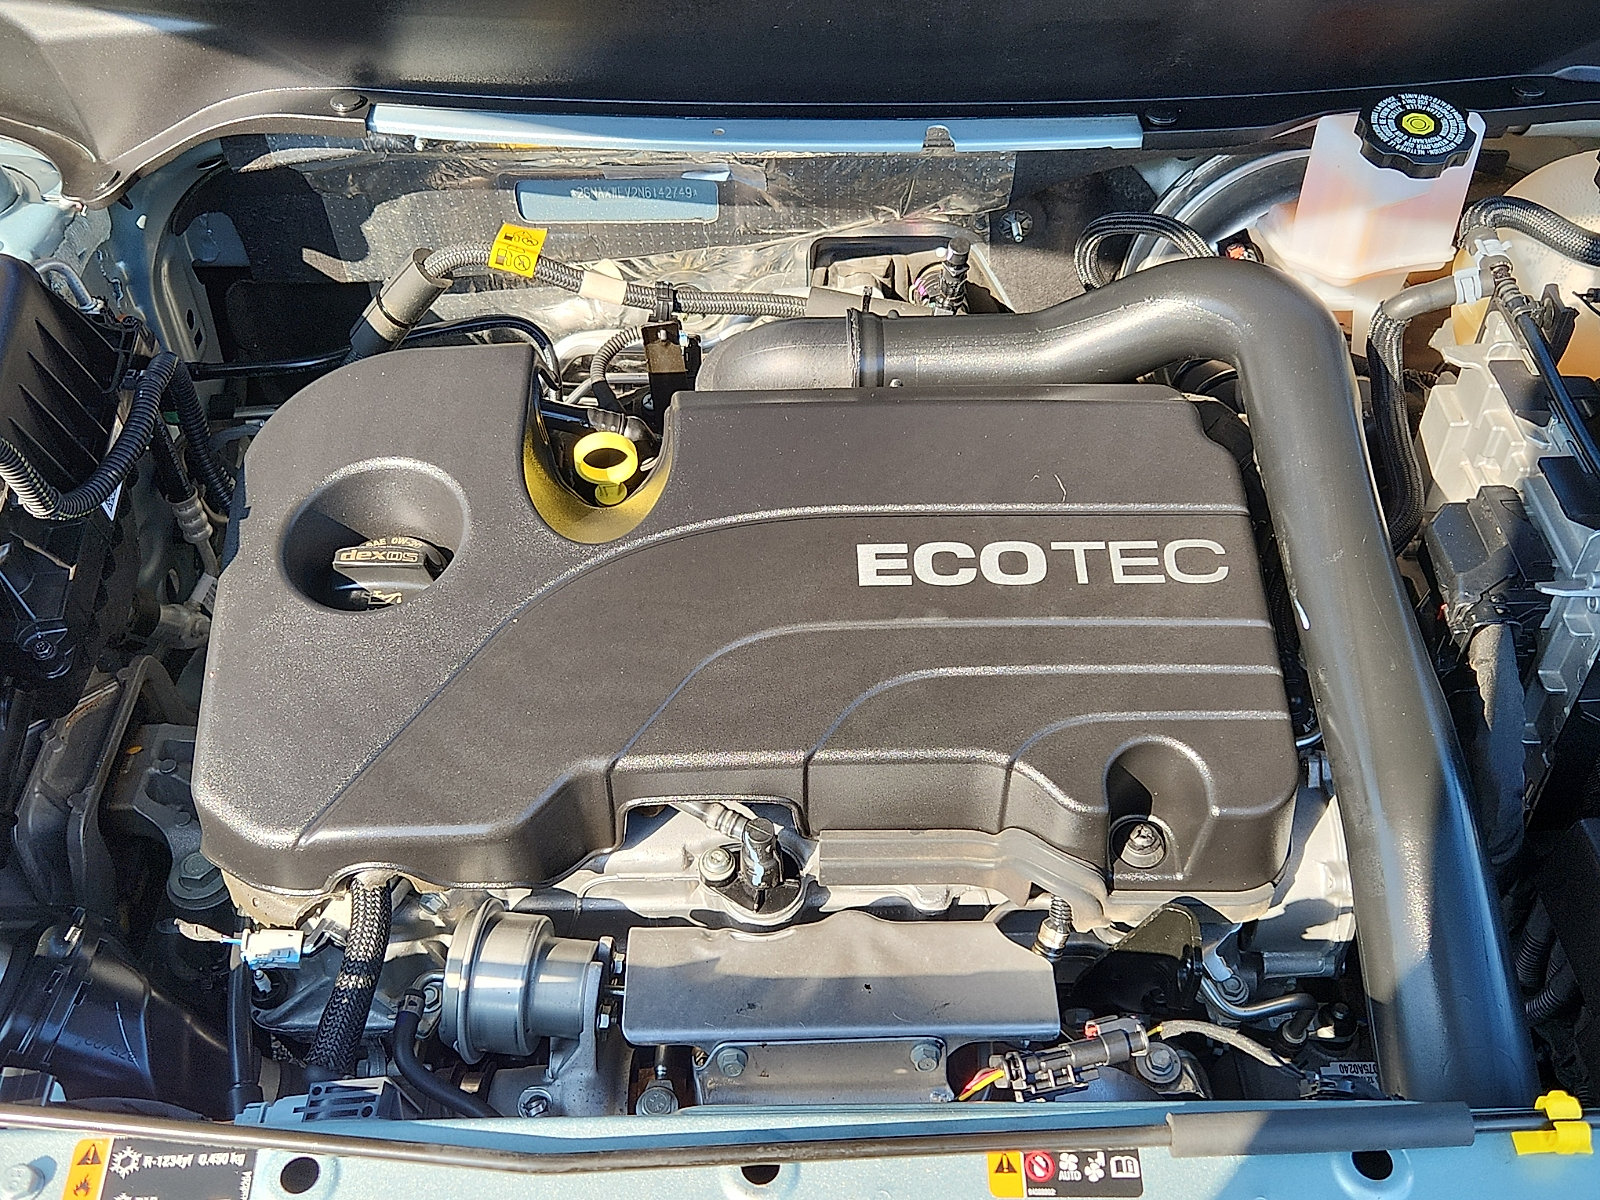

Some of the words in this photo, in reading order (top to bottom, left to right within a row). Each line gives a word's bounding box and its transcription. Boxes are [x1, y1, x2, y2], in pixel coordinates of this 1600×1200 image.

[340, 549, 419, 563] dexos
[856, 539, 1229, 586] ECOTEC
[1058, 1170, 1082, 1181] AUTO
